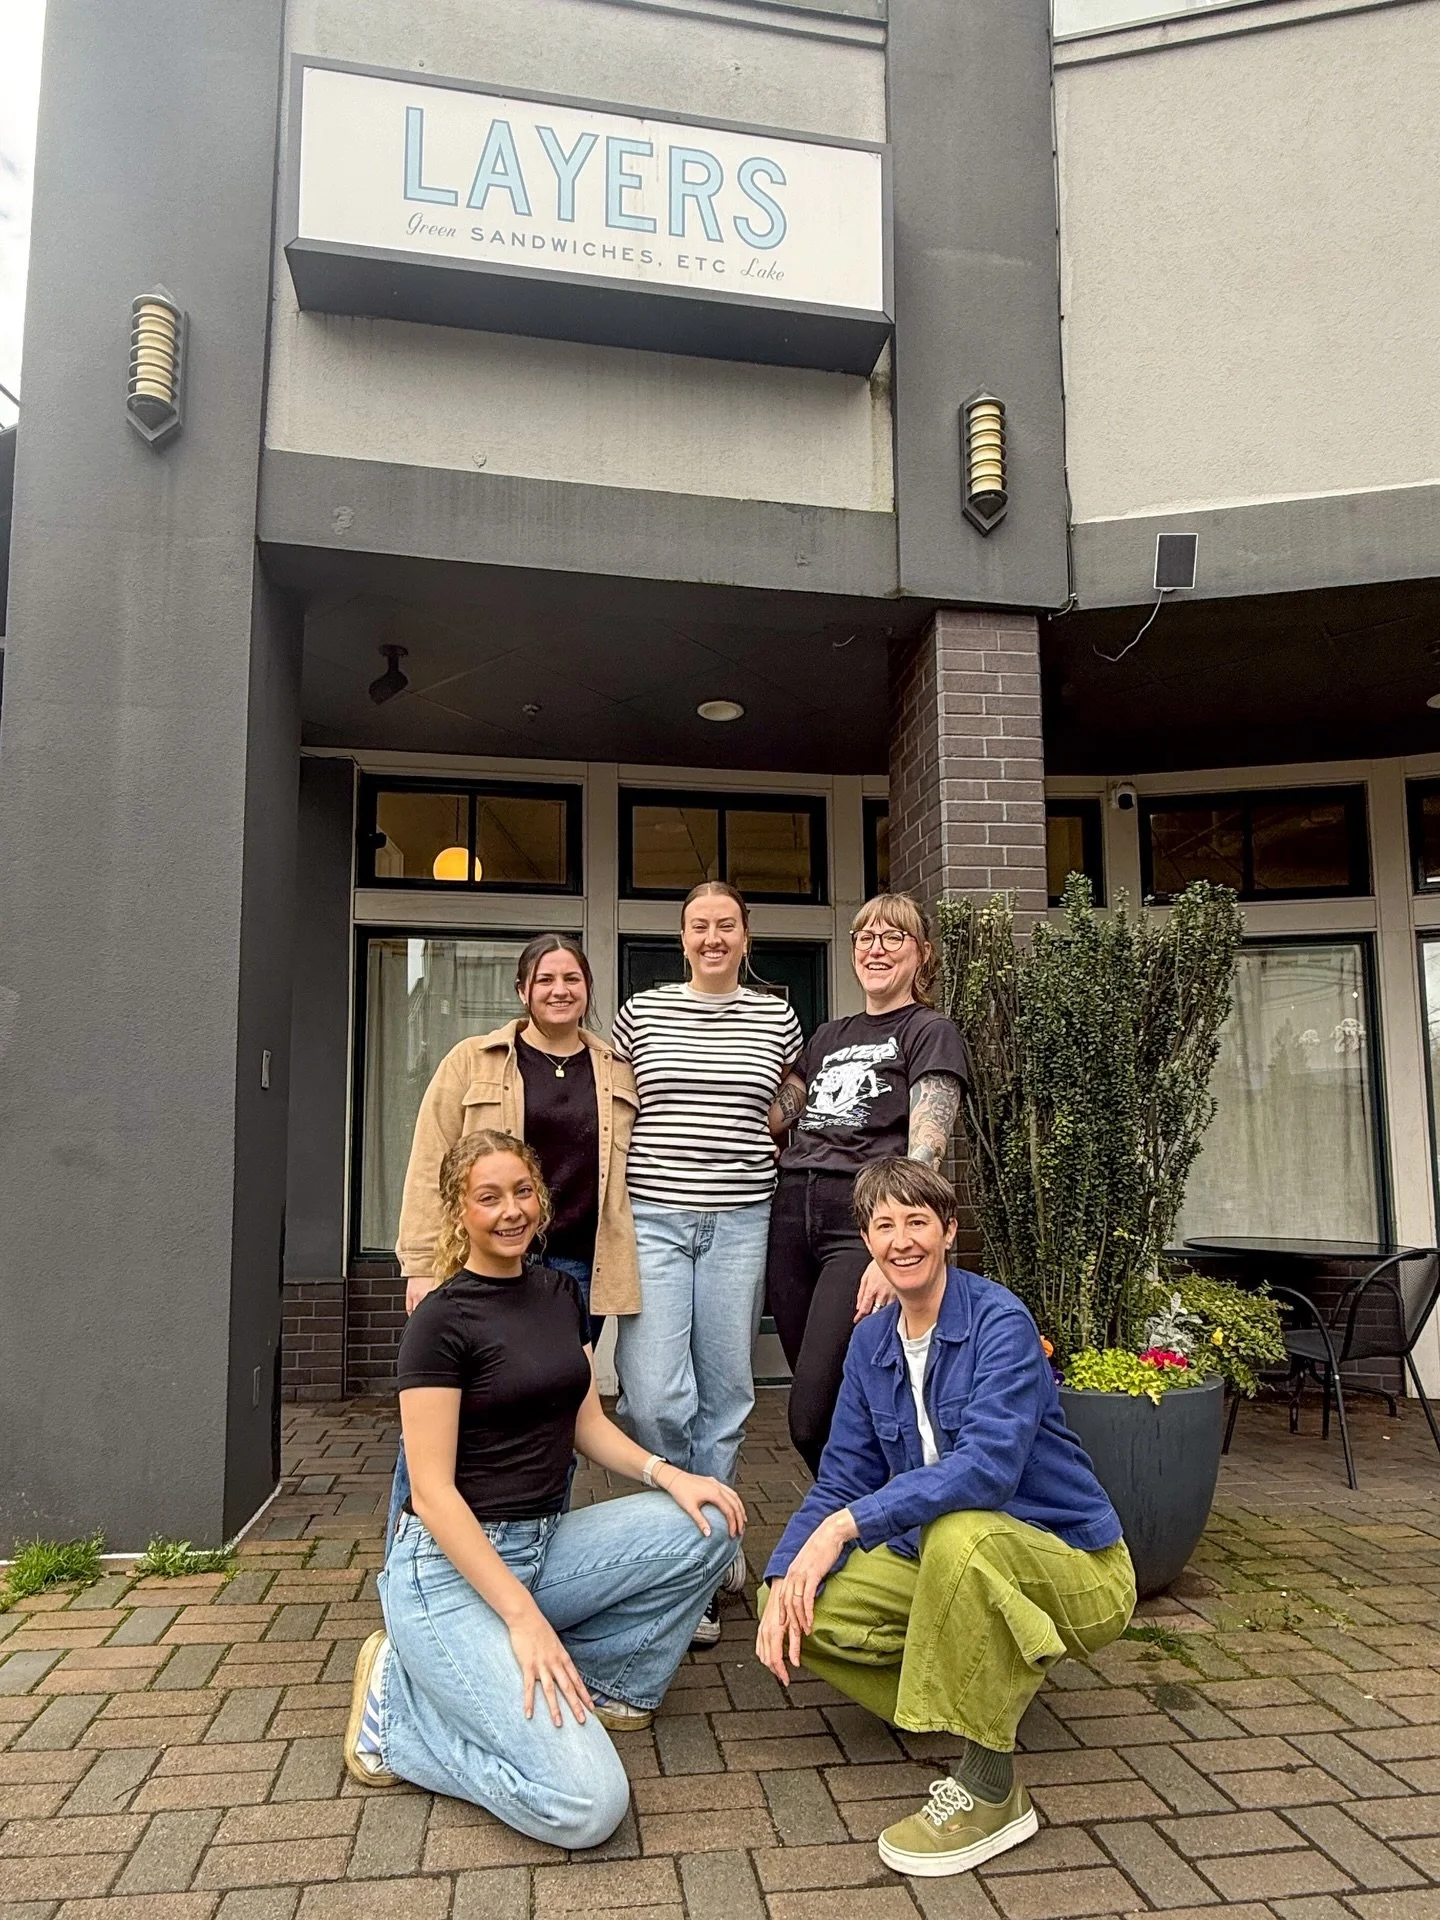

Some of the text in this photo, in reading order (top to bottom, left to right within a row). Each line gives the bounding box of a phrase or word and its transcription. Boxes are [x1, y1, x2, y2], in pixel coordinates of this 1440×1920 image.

[403, 106, 787, 250] LAYERS
[405, 212, 785, 281] Green SANDWICHES, ETC Lake
